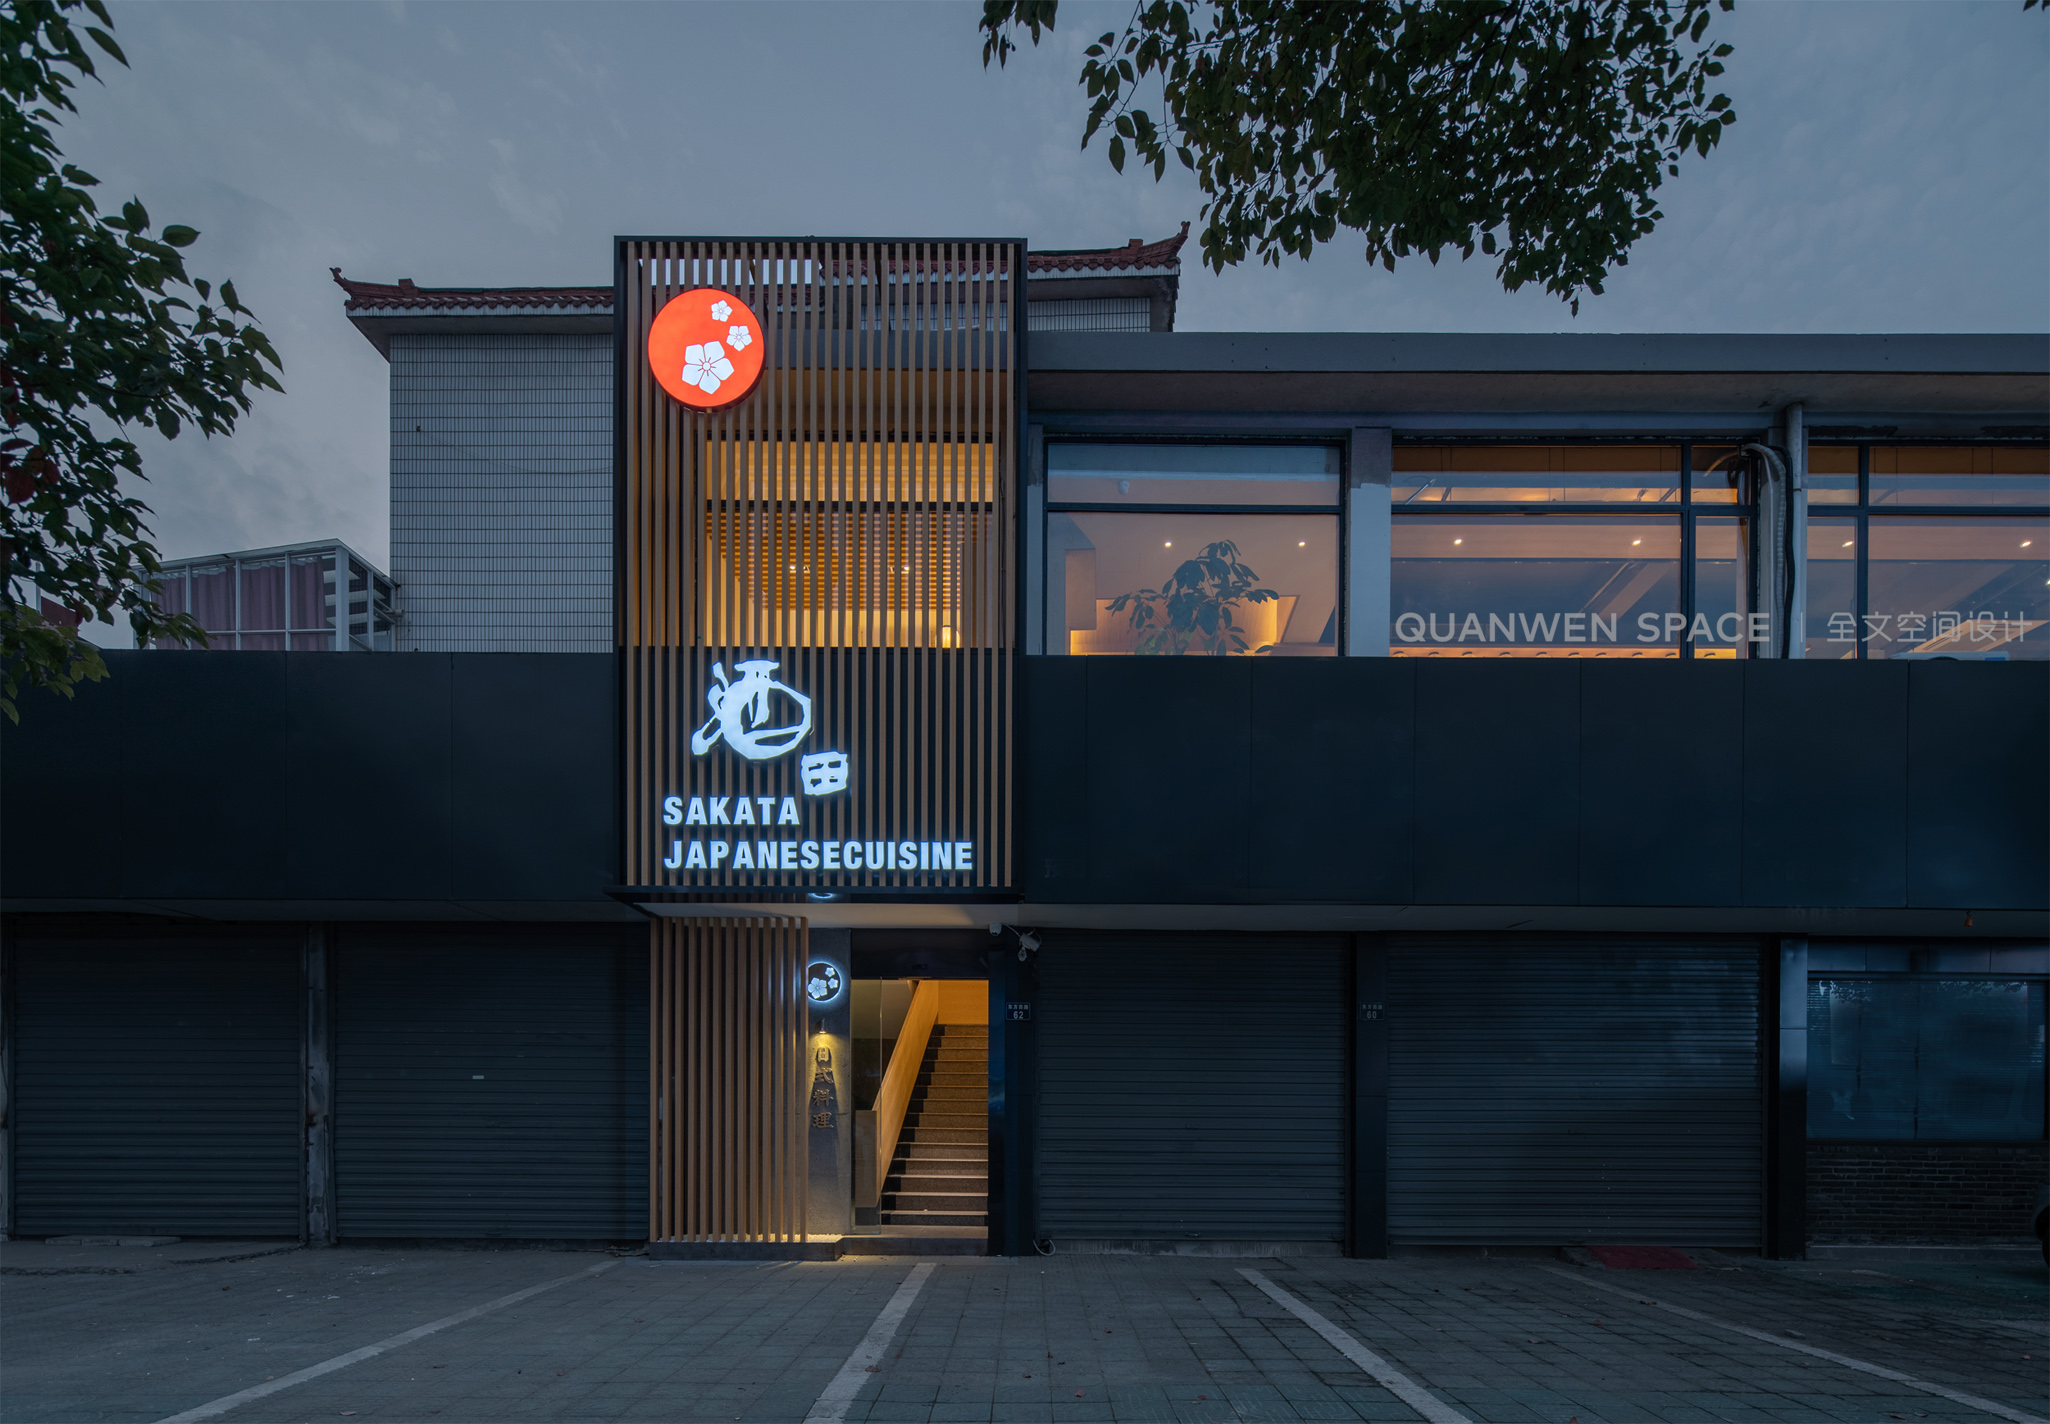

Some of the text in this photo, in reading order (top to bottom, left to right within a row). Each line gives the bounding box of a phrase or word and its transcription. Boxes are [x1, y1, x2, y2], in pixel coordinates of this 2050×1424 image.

[664, 796, 800, 825] SAKATA
[664, 840, 972, 870] JAPANESECUISINE
[1013, 1011, 1024, 1019] 62
[1366, 1011, 1376, 1019] 60
[812, 1046, 834, 1128] 日式料理
